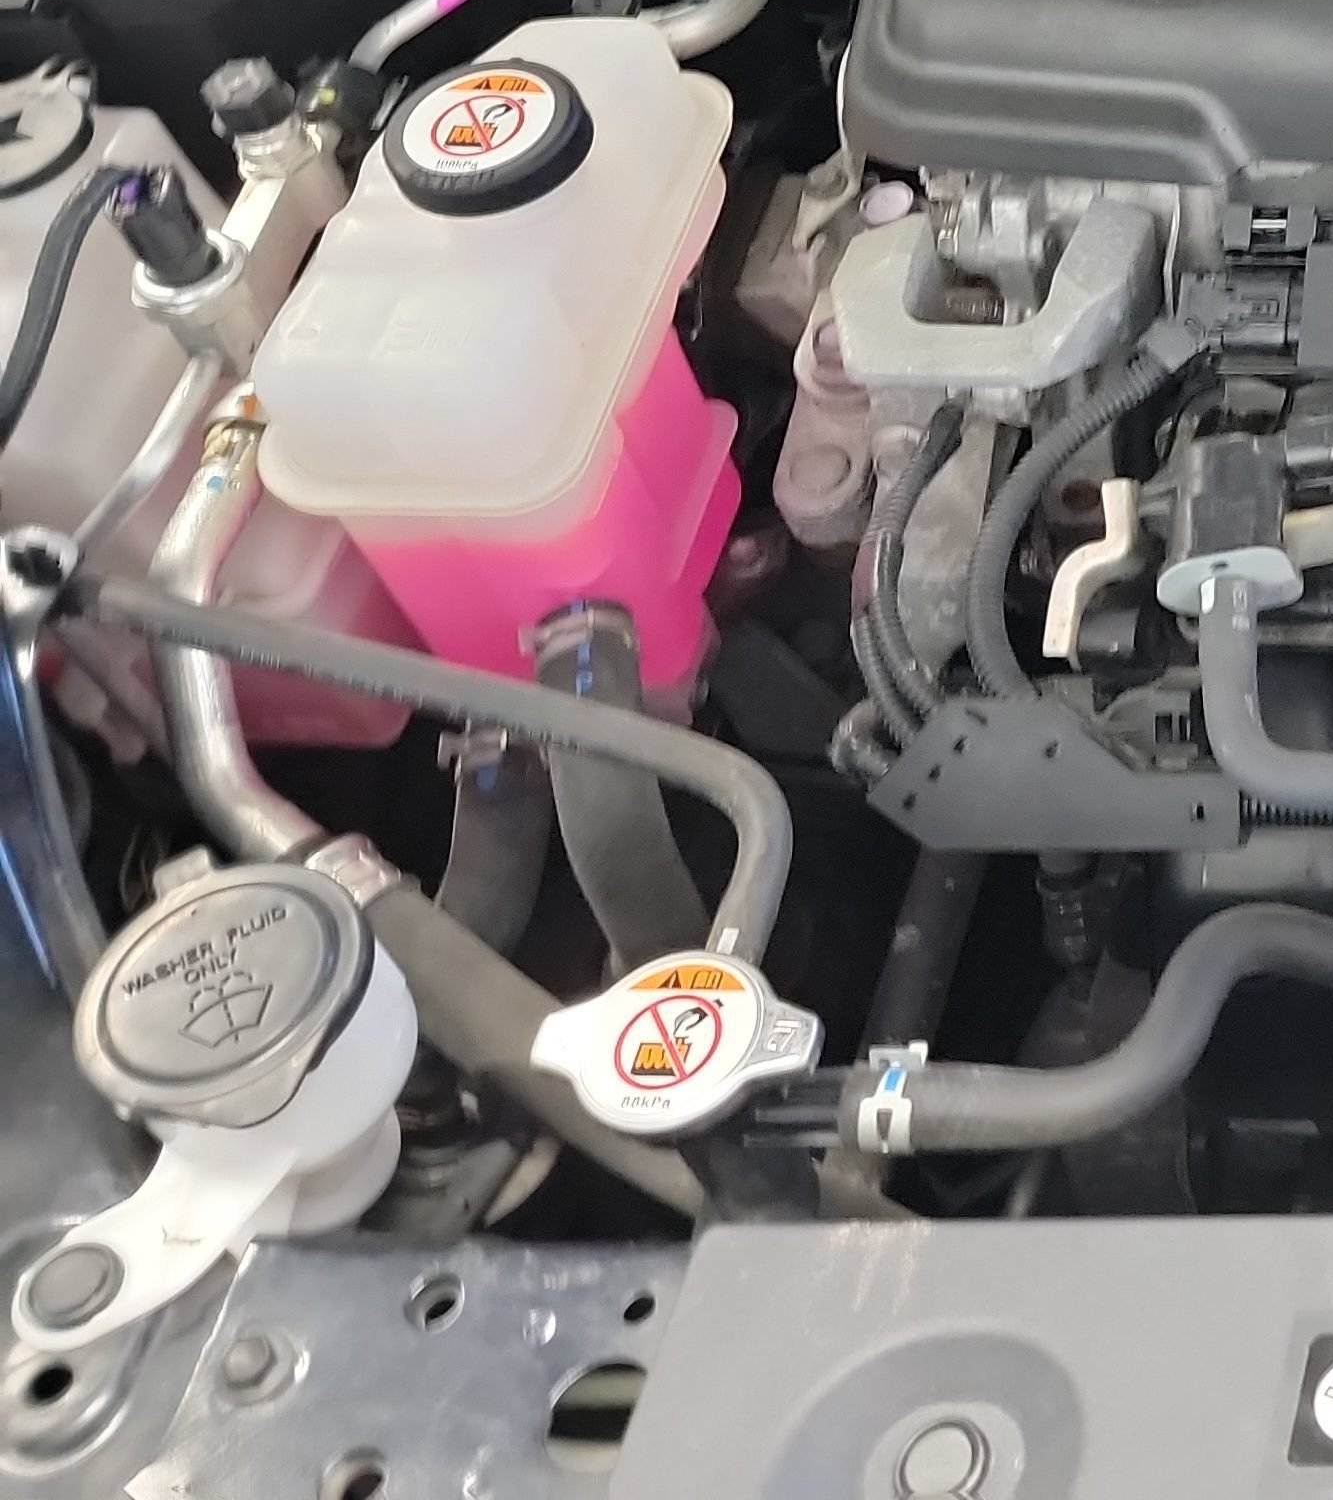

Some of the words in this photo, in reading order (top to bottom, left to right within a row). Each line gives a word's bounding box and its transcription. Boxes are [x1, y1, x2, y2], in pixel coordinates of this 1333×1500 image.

[122, 941, 215, 997] WASHER
[226, 906, 287, 946] FLUID
[184, 947, 237, 985] ONLY
